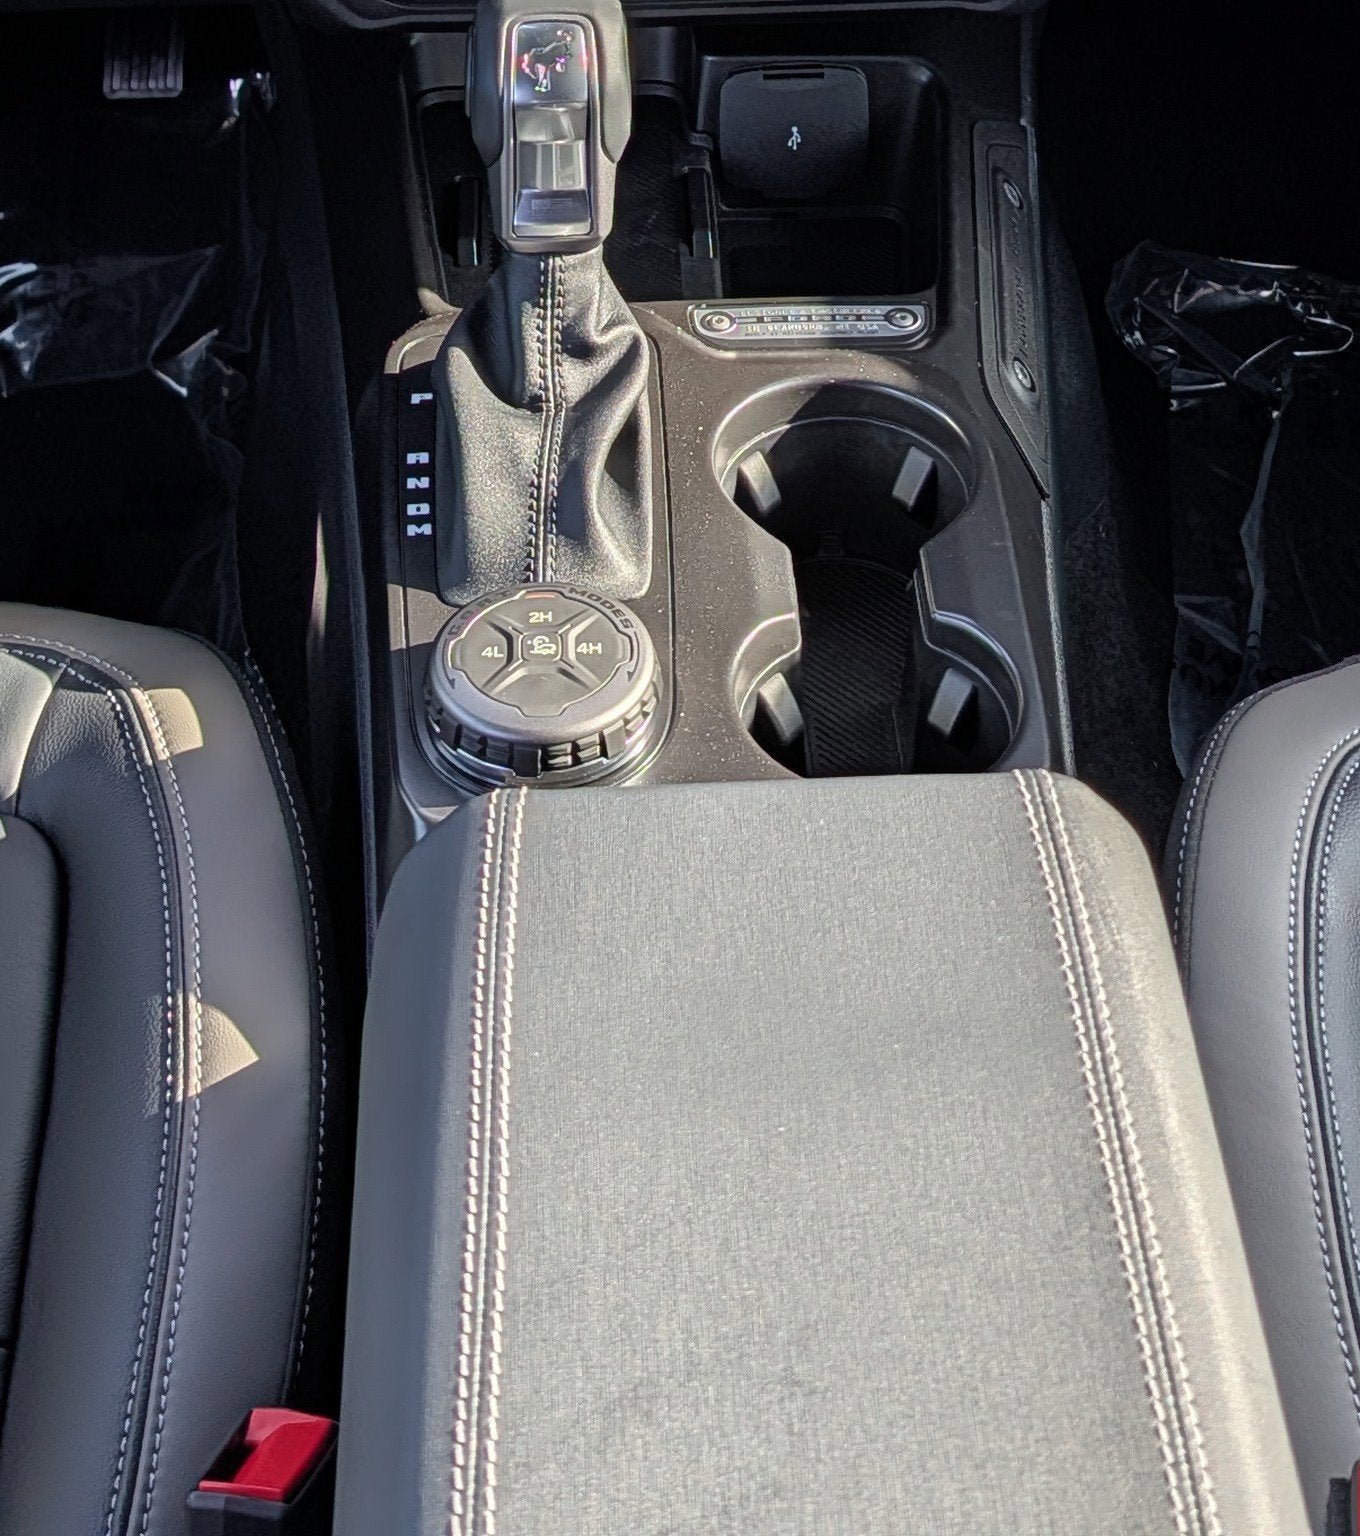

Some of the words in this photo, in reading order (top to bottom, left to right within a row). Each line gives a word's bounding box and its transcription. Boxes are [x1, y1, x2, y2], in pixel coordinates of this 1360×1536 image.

[410, 393, 433, 404] P
[406, 476, 430, 489] N
[406, 523, 432, 536] M
[569, 587, 635, 629] MODES
[528, 610, 553, 623] 2H
[481, 646, 505, 658] 4L
[576, 642, 603, 654] 4H
